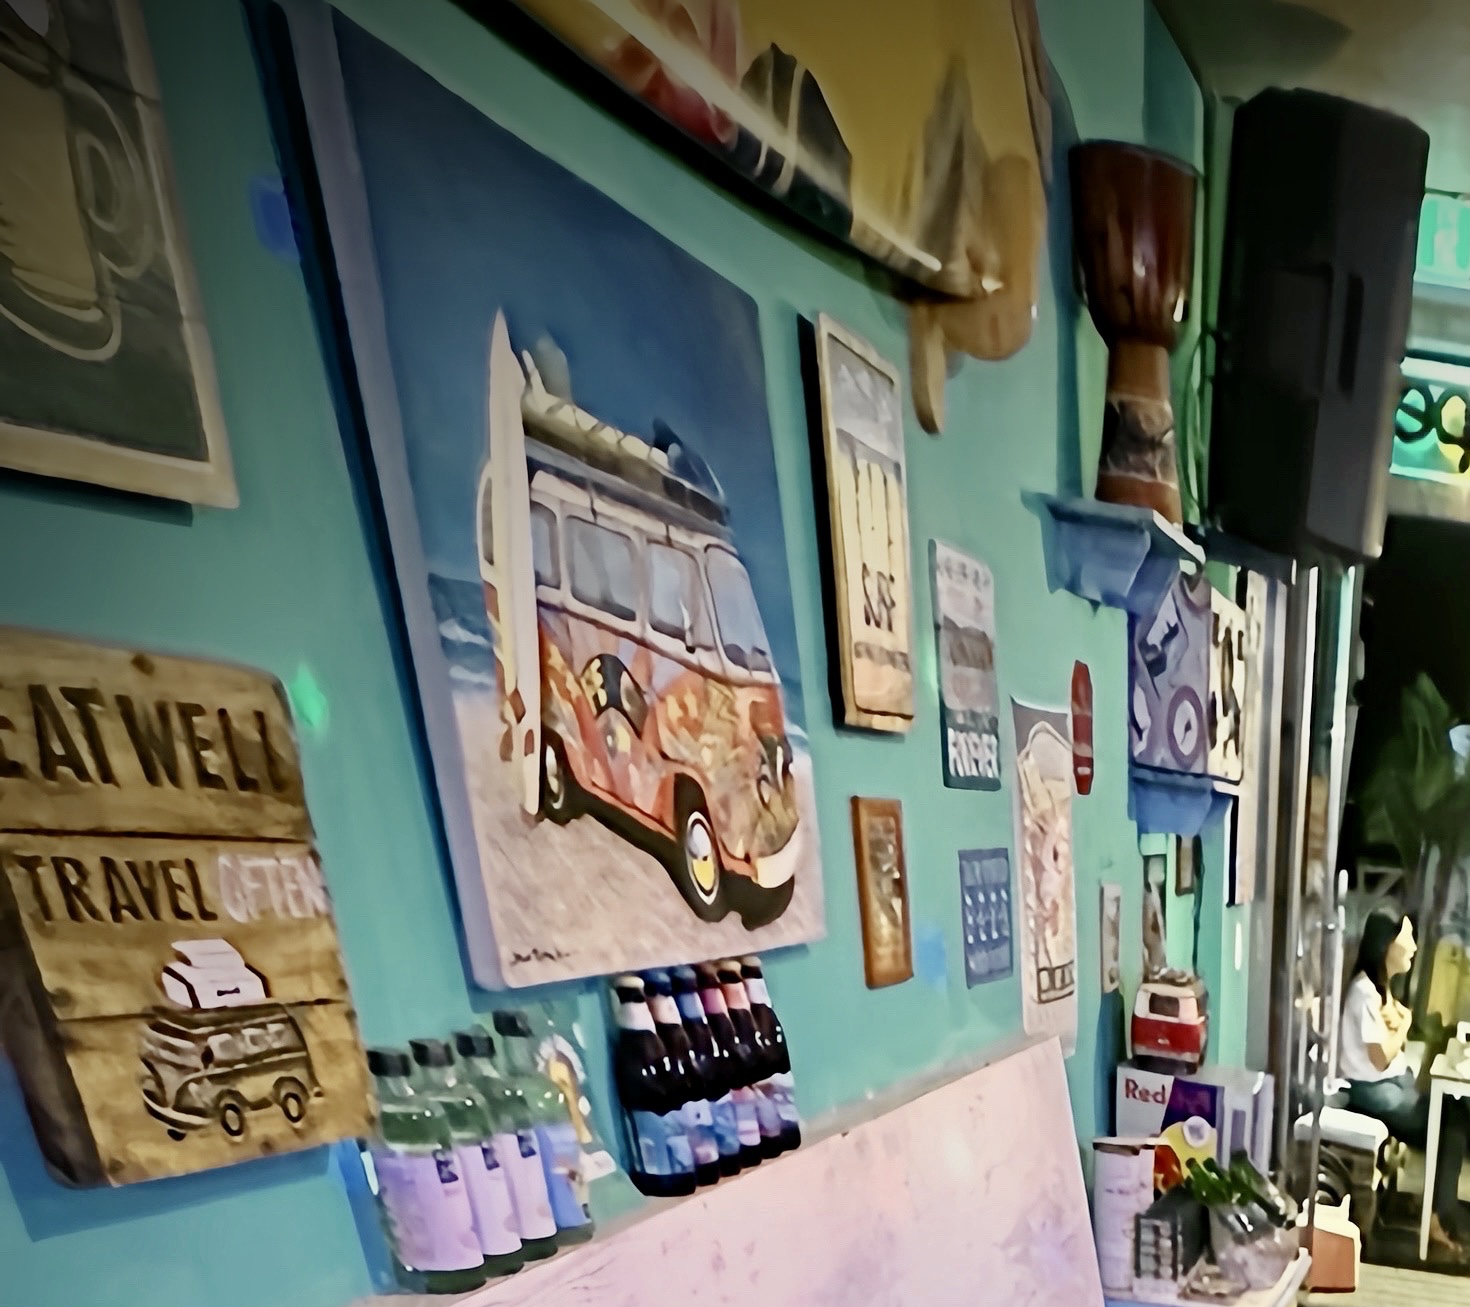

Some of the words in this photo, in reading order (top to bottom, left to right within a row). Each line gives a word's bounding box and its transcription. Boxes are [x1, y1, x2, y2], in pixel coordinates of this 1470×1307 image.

[114, 693, 288, 793] WELL
[13, 854, 218, 923] TRAVEL
[1124, 1078, 1167, 1105] Red
